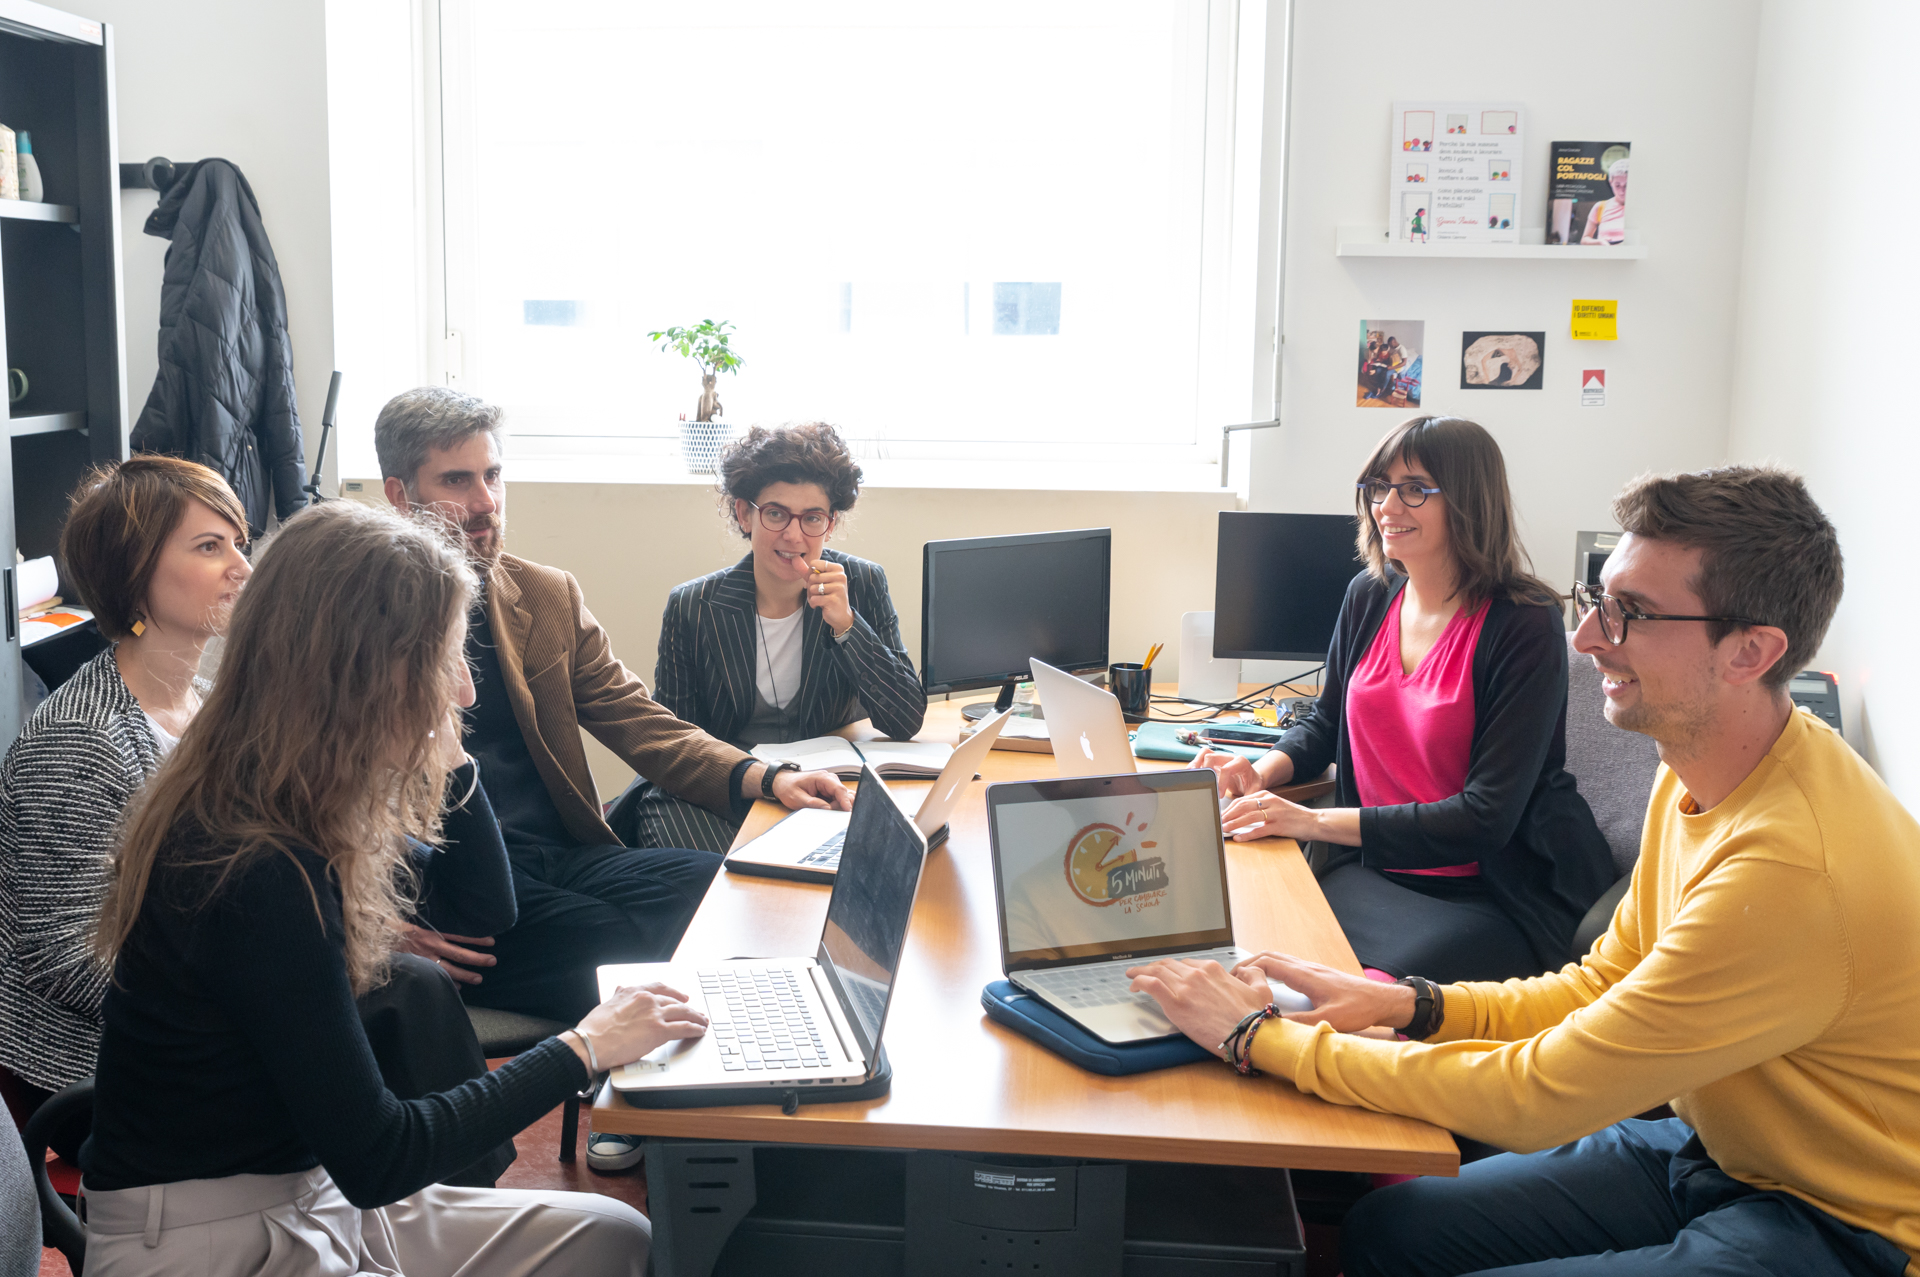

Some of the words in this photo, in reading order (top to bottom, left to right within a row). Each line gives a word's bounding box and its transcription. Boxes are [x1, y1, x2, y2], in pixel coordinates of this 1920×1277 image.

[1556, 172, 1607, 180] PORTAFOGLI
[1112, 870, 1123, 894] 5
[1125, 862, 1162, 891] MINUTI
[1119, 896, 1132, 906] PER
[1134, 890, 1167, 902] CAMBIARE
[1124, 906, 1131, 914] LA
[1136, 900, 1160, 912] SCUOLA
